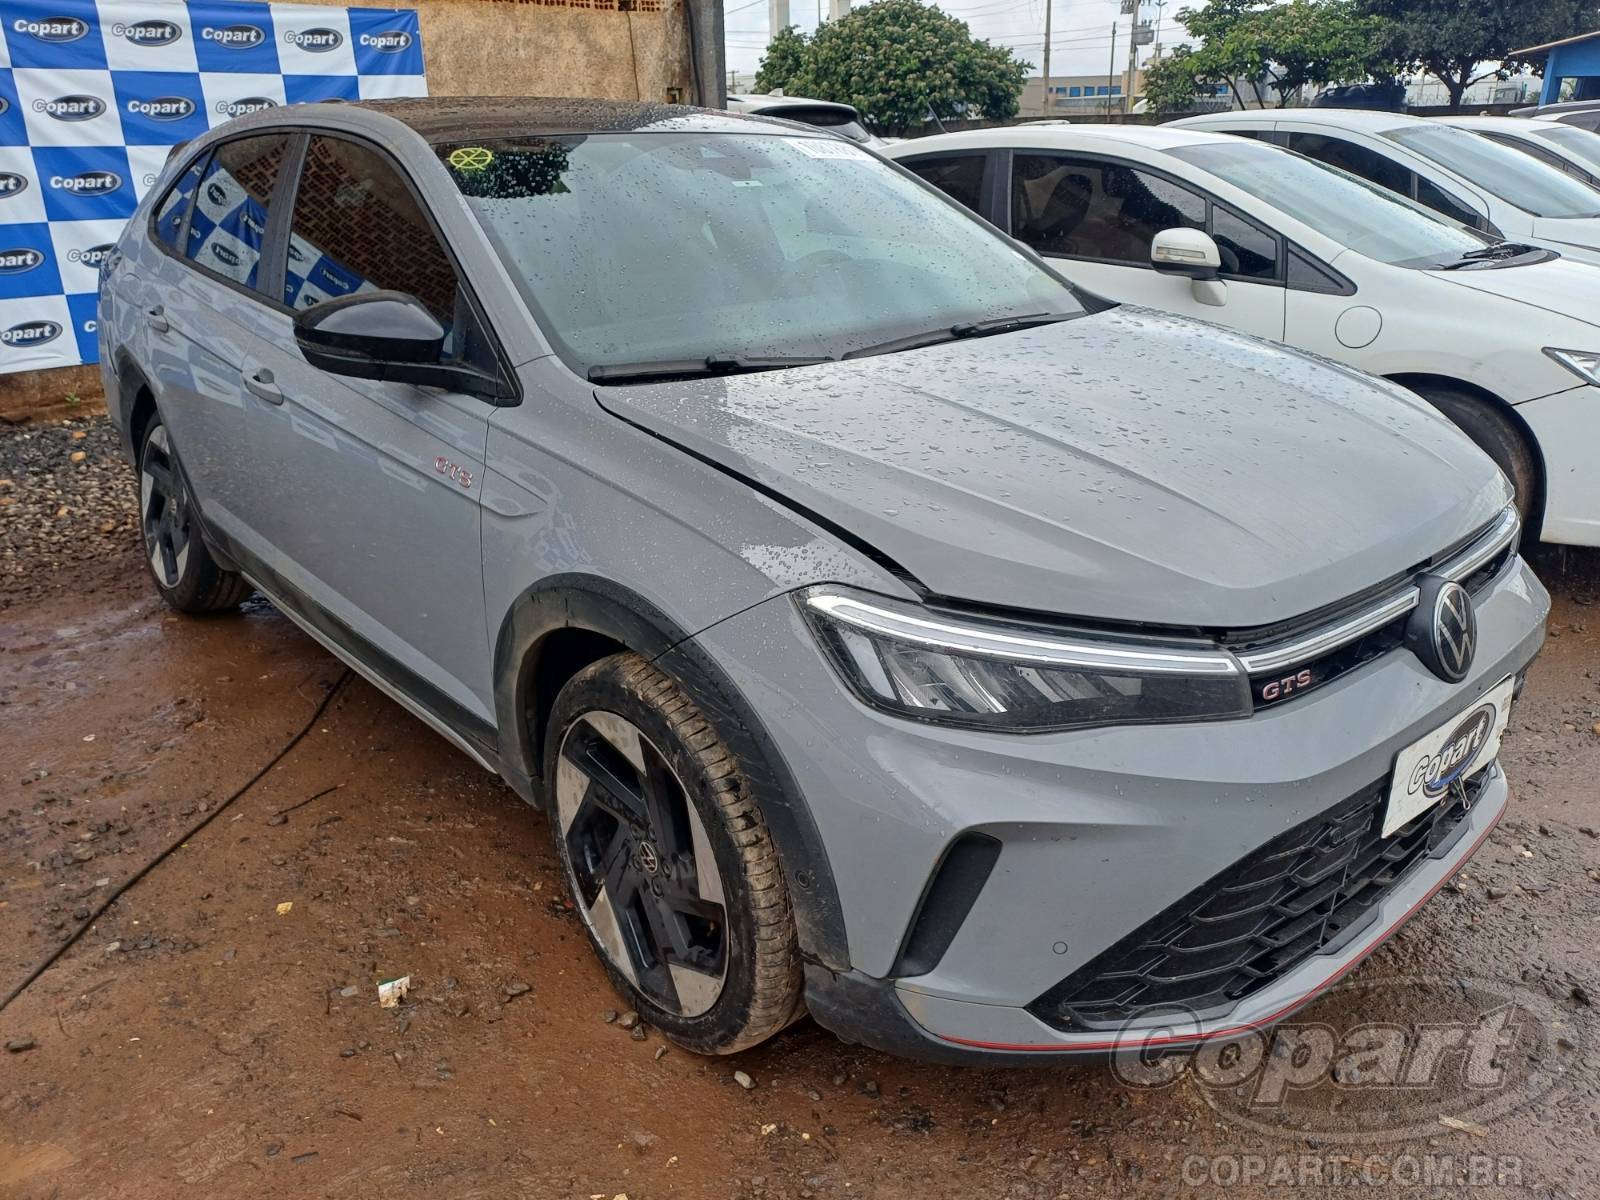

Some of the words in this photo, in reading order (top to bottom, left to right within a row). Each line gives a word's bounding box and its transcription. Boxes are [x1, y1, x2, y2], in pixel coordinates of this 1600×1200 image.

[14, 19, 80, 36] Copart
[112, 22, 172, 39] Copart
[201, 27, 257, 43] Copart
[284, 30, 335, 46] Copart
[360, 34, 405, 48] Copart
[32, 98, 97, 114] Copart
[127, 100, 187, 115] Copart
[50, 175, 113, 190] Copart
[0, 324, 52, 343] opart
[434, 456, 473, 488] GTS
[1262, 668, 1312, 701] GTS
[1407, 711, 1488, 796] Copart
